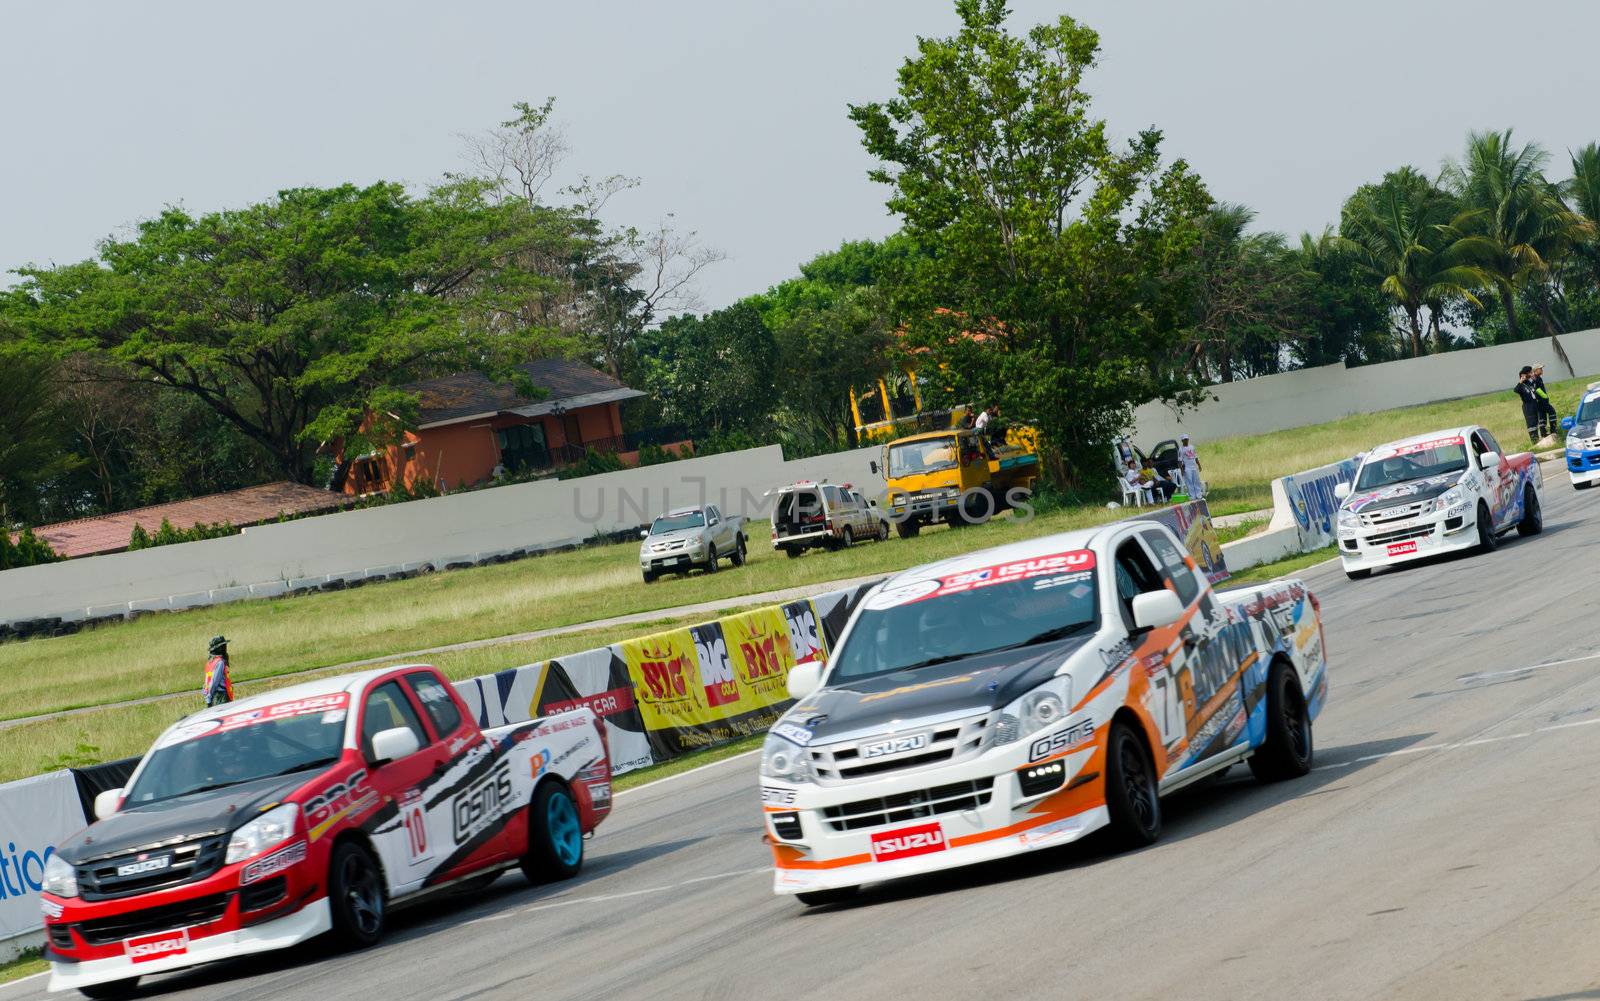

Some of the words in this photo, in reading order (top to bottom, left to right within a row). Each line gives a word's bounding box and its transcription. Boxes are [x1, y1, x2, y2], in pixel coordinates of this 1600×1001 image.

[1388, 542, 1417, 554] ISUZU
[999, 553, 1089, 576] ISUZU
[593, 695, 618, 714] CAR
[1155, 676, 1170, 737] 7
[863, 734, 925, 759] ISUZU
[405, 807, 427, 858] 10
[872, 829, 943, 856] ISUZU
[128, 936, 186, 957] ISUZU
